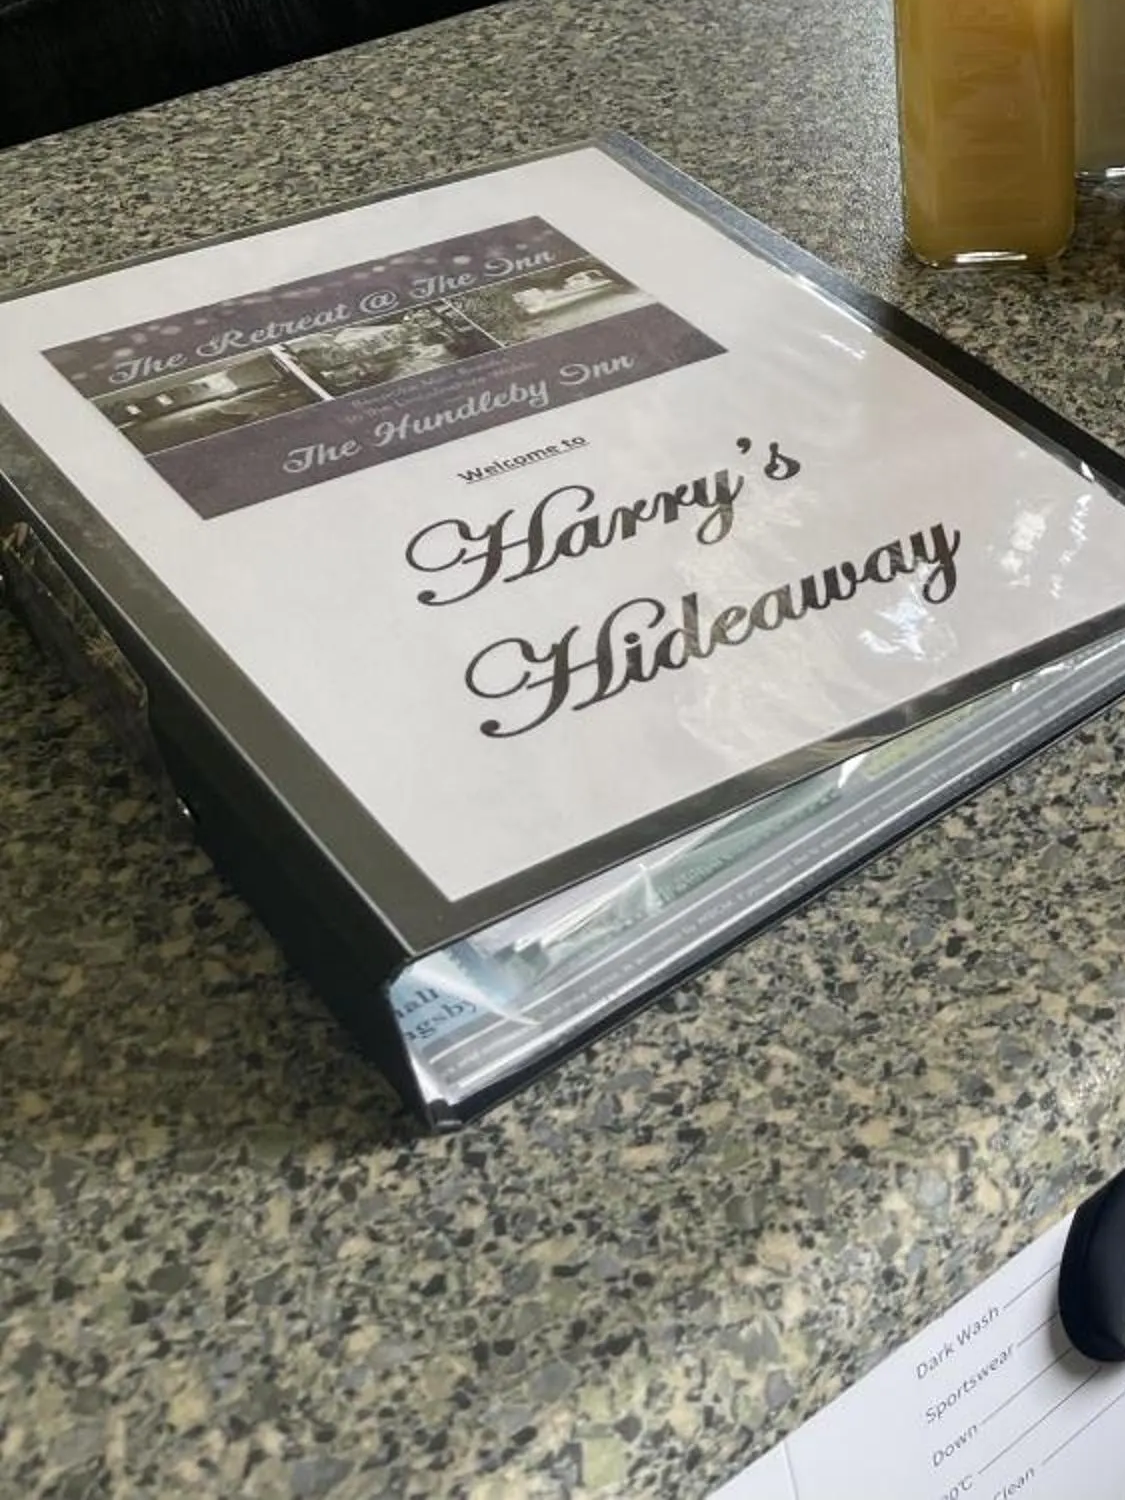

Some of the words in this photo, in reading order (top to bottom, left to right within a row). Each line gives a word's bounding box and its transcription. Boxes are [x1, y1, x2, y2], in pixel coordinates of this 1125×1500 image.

[106, 349, 187, 387] The
[195, 302, 353, 358] Retreat
[357, 289, 399, 321] @
[410, 268, 477, 301] The
[483, 246, 559, 284] Inn
[281, 435, 362, 477] The
[371, 376, 553, 449] Hundleby
[557, 350, 636, 388] Inn
[458, 441, 555, 483] Welcome
[557, 433, 589, 455] to
[405, 436, 801, 607] Harry's
[464, 521, 961, 738] Hideaway
[915, 1340, 957, 1381] Dark
[955, 1305, 1000, 1348] Wash
[925, 1343, 1015, 1426] Sportswear
[932, 1423, 979, 1469] Down
